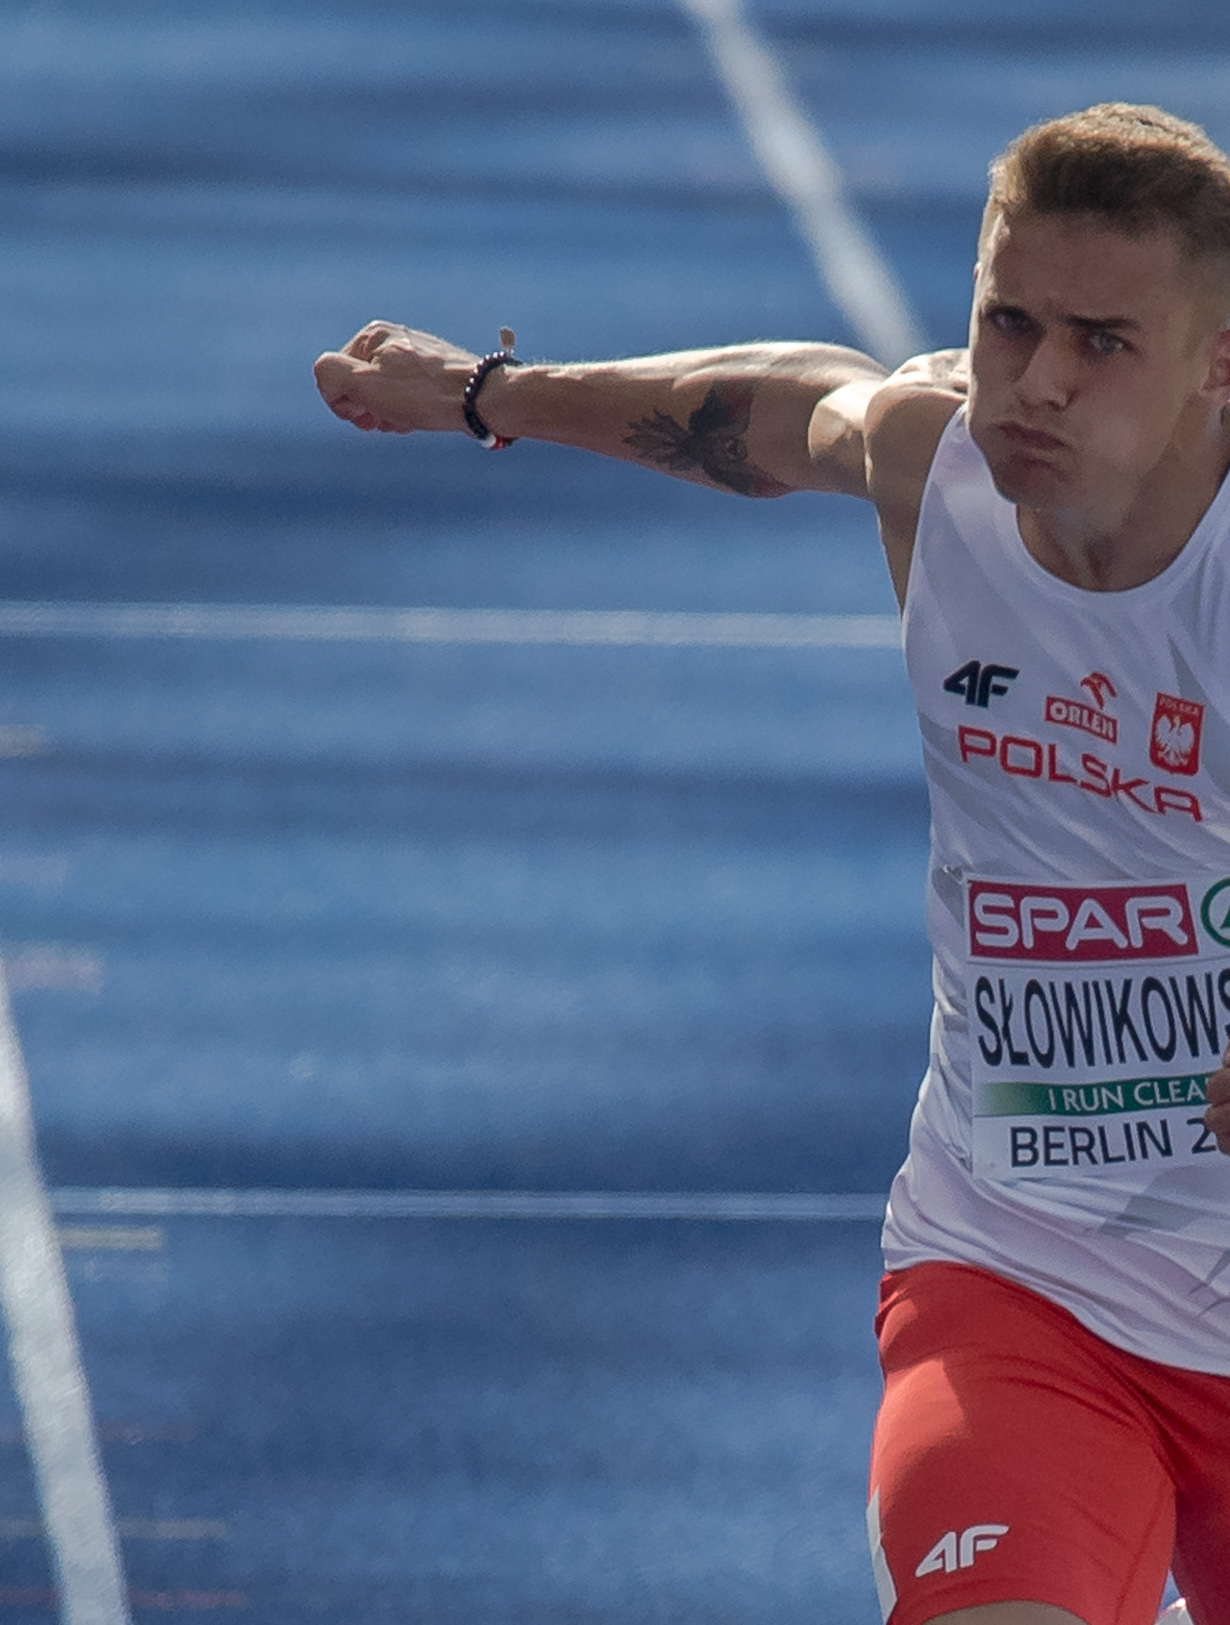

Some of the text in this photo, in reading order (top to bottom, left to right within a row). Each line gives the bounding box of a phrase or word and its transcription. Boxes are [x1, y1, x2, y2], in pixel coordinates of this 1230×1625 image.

[943, 660, 1019, 707] 4F
[958, 725, 1203, 822] POLSKA
[974, 893, 1188, 951] SPAR
[1048, 1077, 1212, 1112] I RUN CLEA
[1010, 1119, 1173, 1167] BERLIN
[914, 1524, 1010, 1578] 4F
